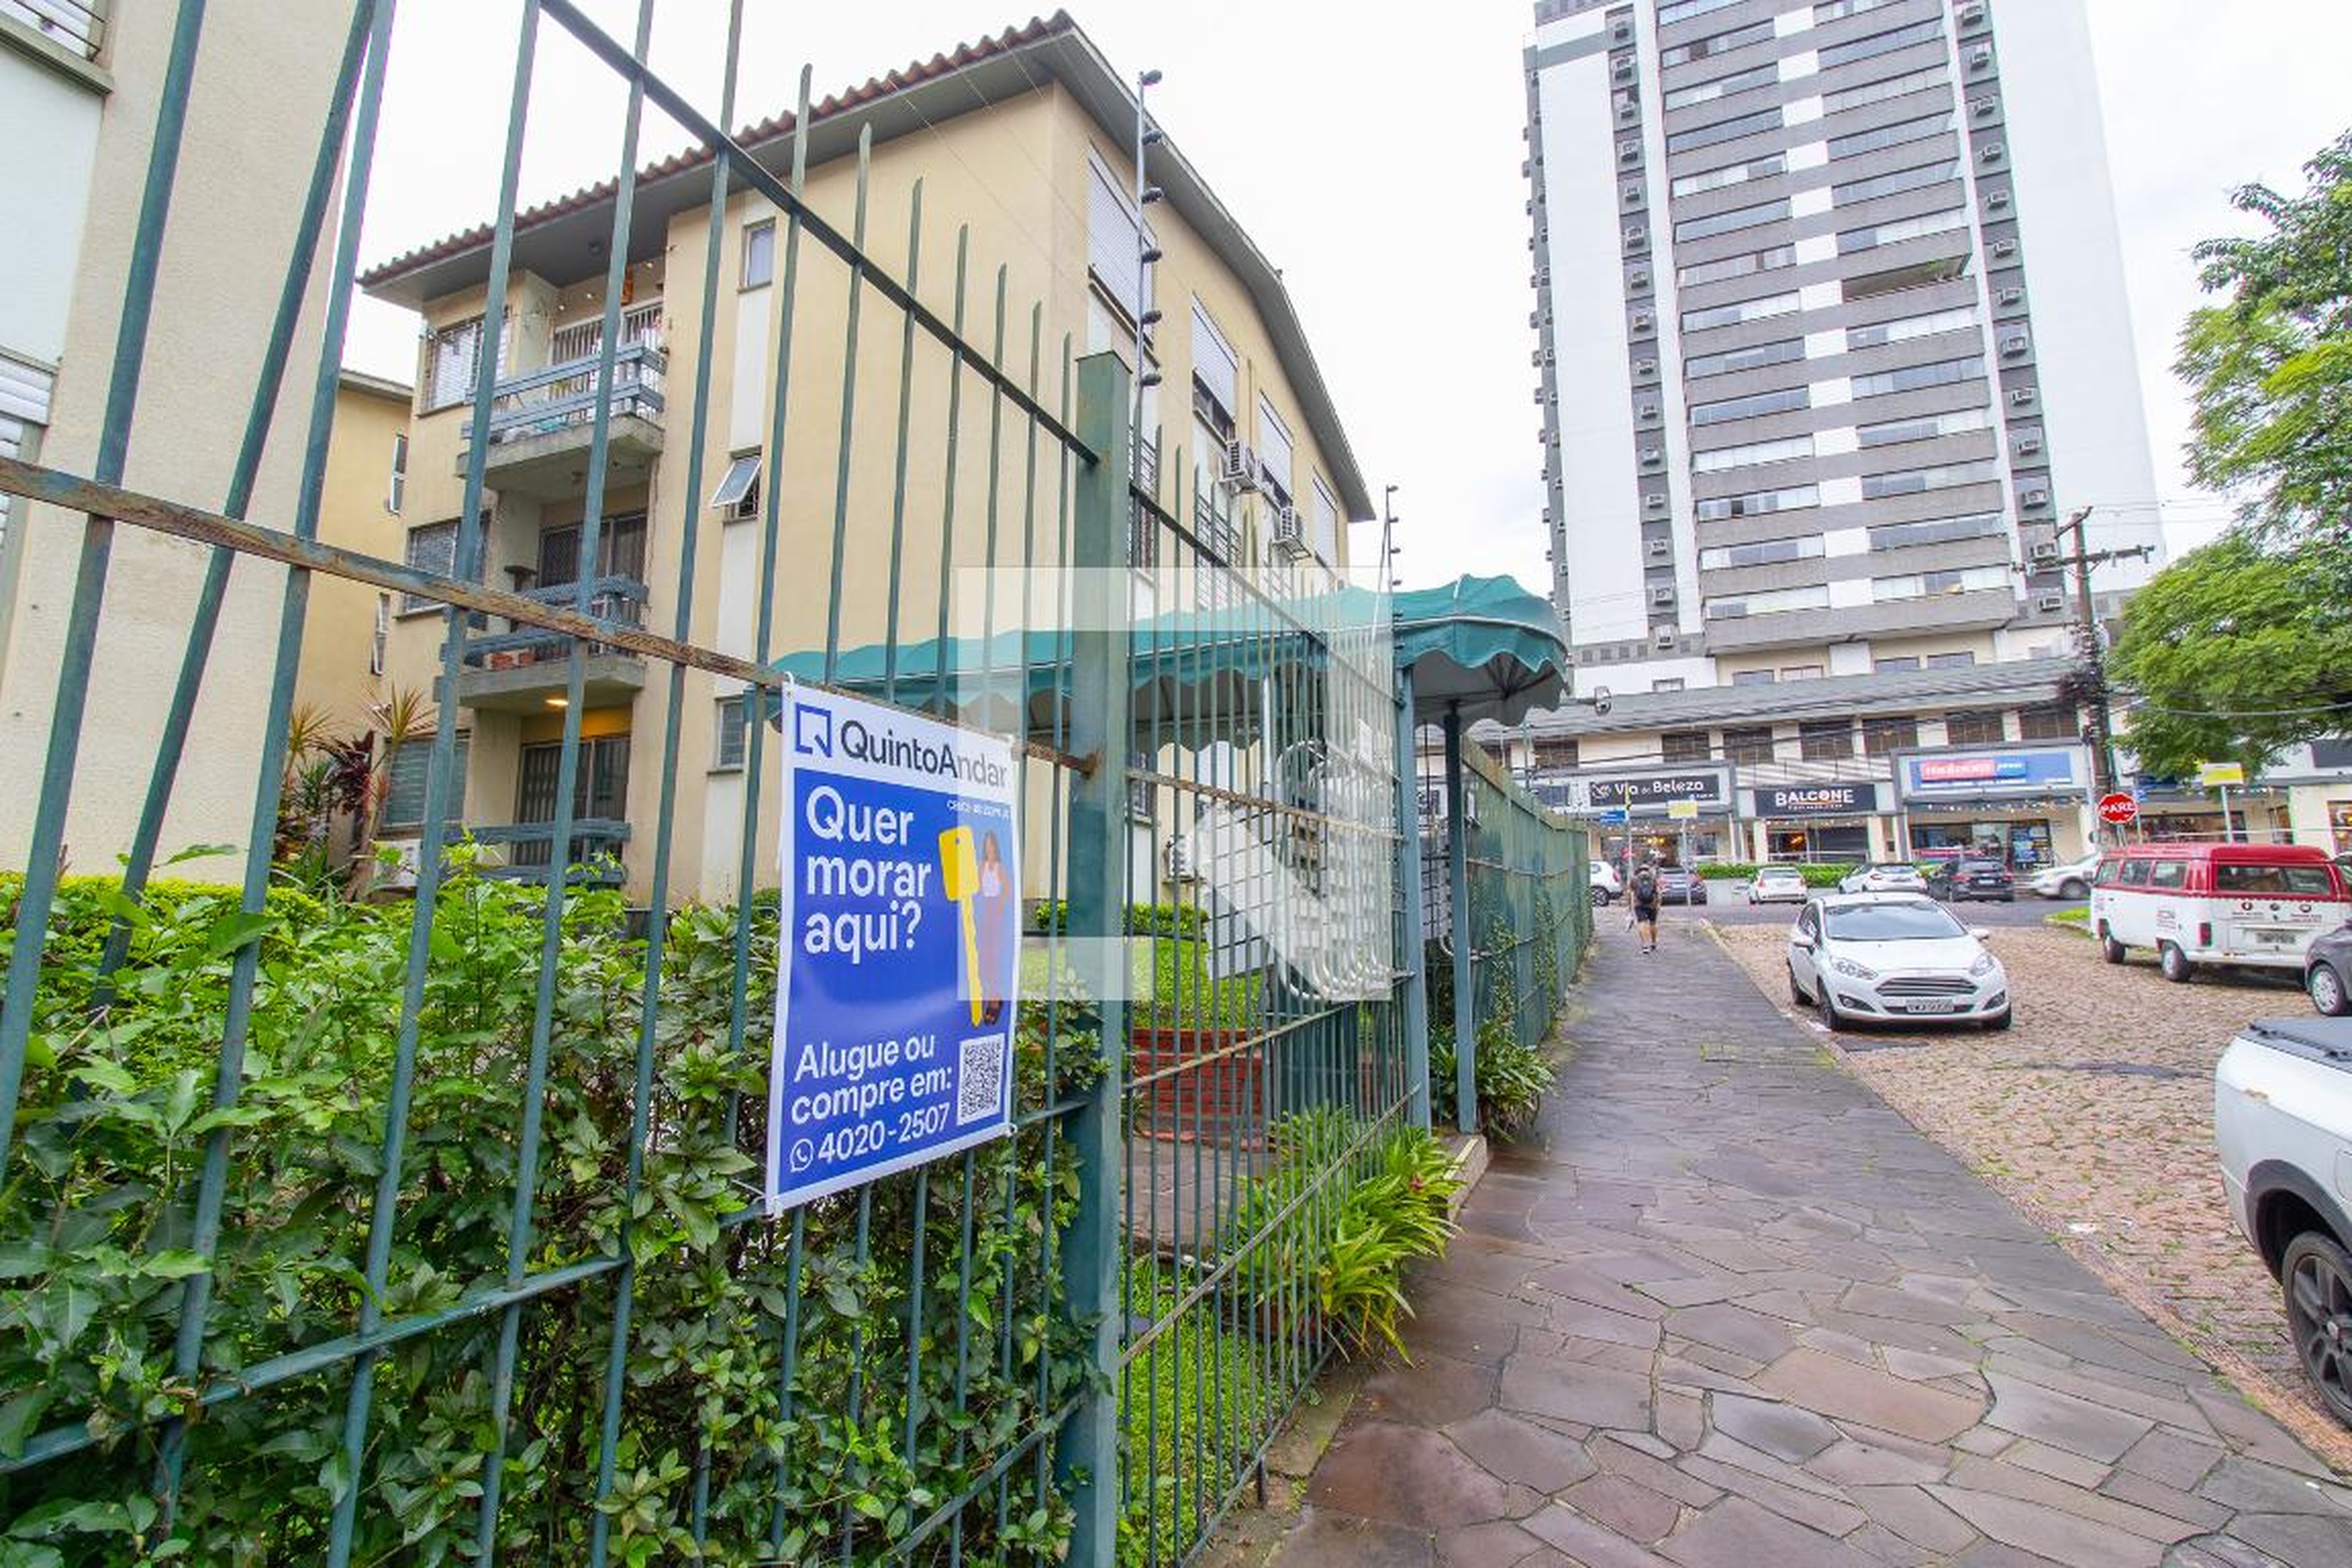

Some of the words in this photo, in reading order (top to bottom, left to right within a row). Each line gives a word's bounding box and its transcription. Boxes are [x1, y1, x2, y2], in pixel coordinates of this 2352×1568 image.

[840, 720, 1007, 788] QuintoAndar
[1614, 783, 1639, 795] Va
[1653, 780, 1704, 794] Beleza
[1775, 789, 1855, 807] BALCONE
[2100, 802, 2136, 815] PARE
[806, 785, 914, 846] Quer
[807, 855, 932, 897] morar
[804, 900, 922, 965] aqui?
[793, 1041, 900, 1080] Alugue
[905, 1035, 935, 1061] ou
[791, 1077, 905, 1125] compre
[910, 1067, 952, 1096] em:
[818, 1102, 950, 1163] 4020-2507
